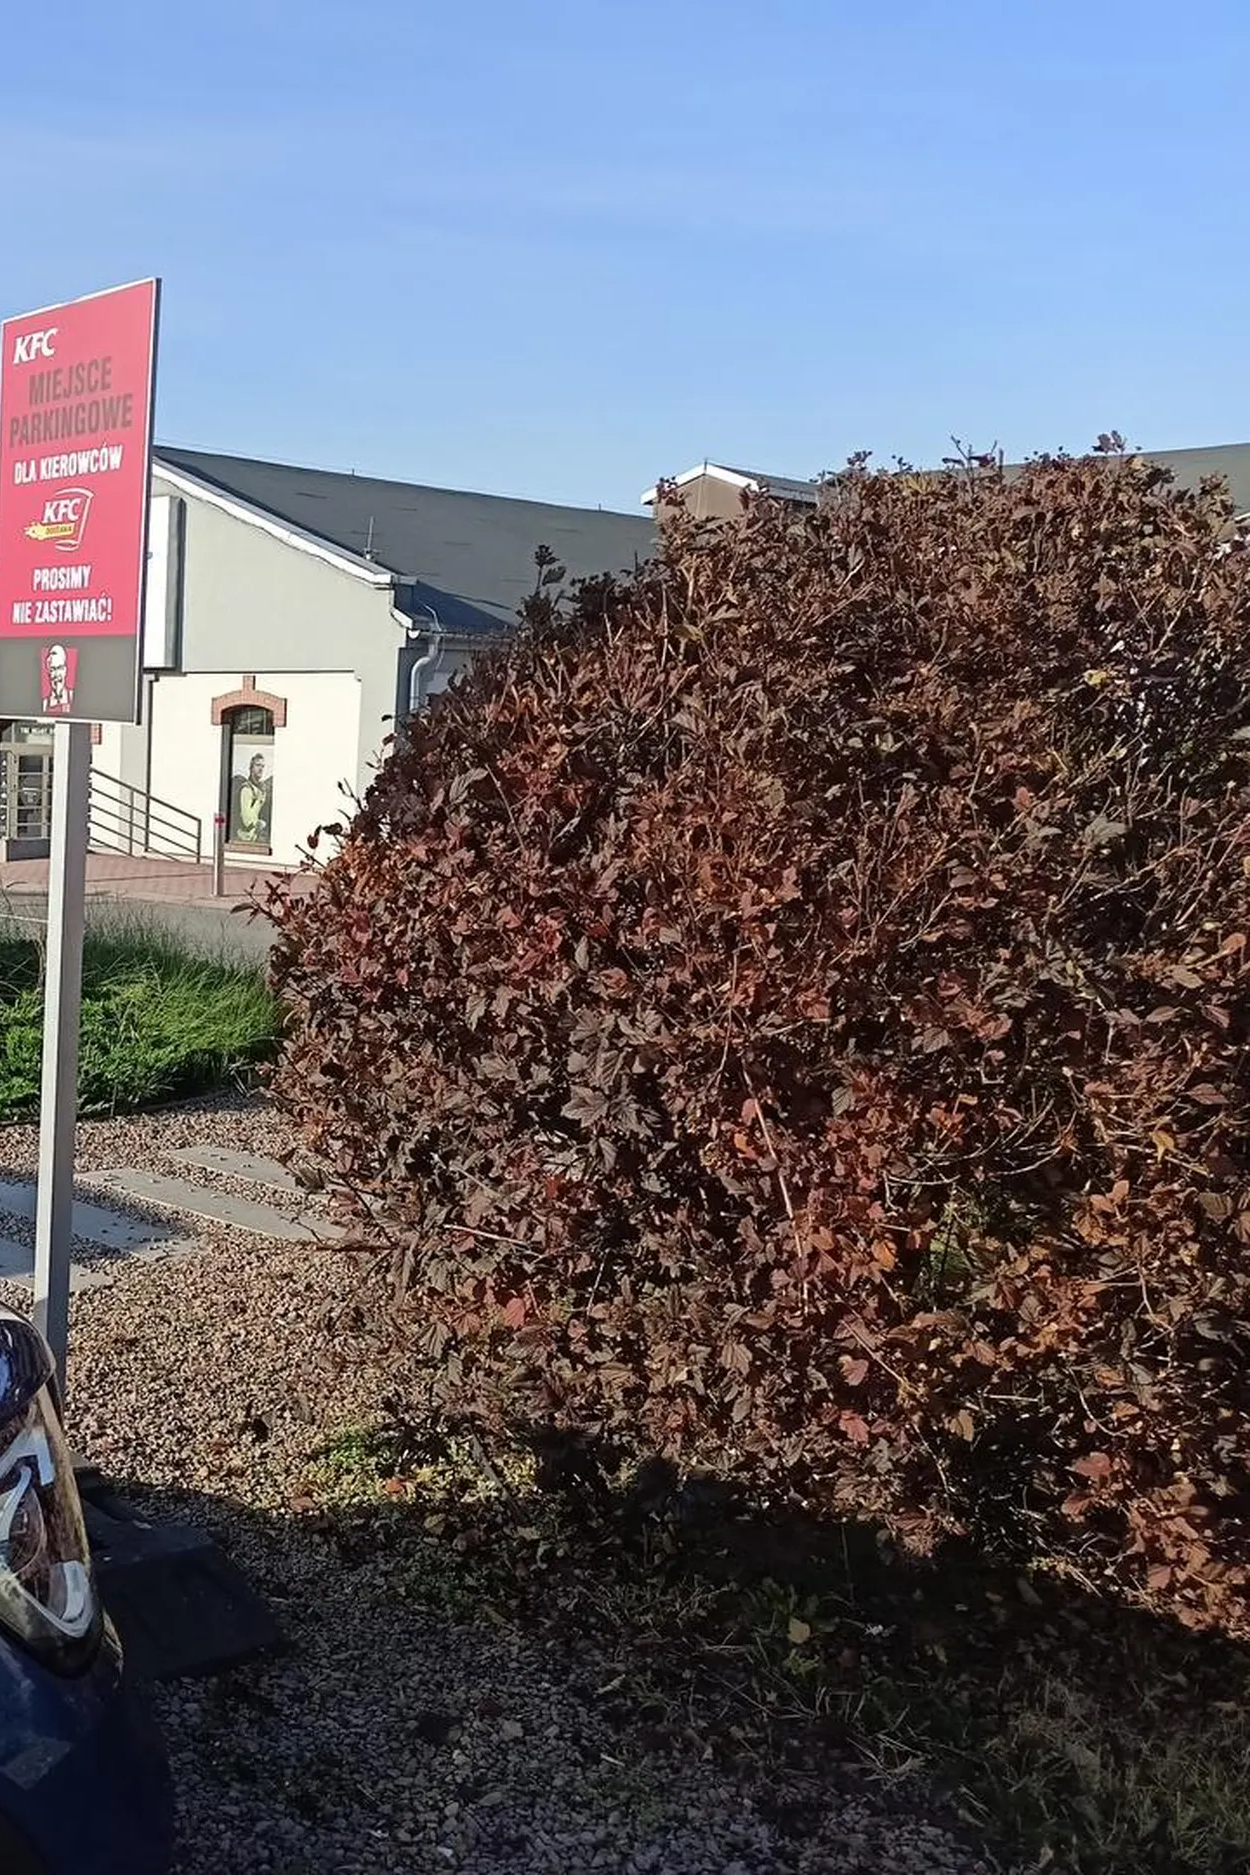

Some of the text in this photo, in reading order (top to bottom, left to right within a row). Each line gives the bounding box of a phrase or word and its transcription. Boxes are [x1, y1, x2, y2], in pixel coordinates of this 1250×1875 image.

[13, 328, 58, 364] KFC
[29, 356, 112, 406] MIEJSCE
[10, 393, 133, 448] PARKINGOWE
[14, 442, 123, 484] DLA KIEROWCÓW
[42, 498, 82, 523] KFC
[32, 565, 92, 592] PROSIMY
[12, 592, 112, 624] NIE ZASTAWIAĆ!
